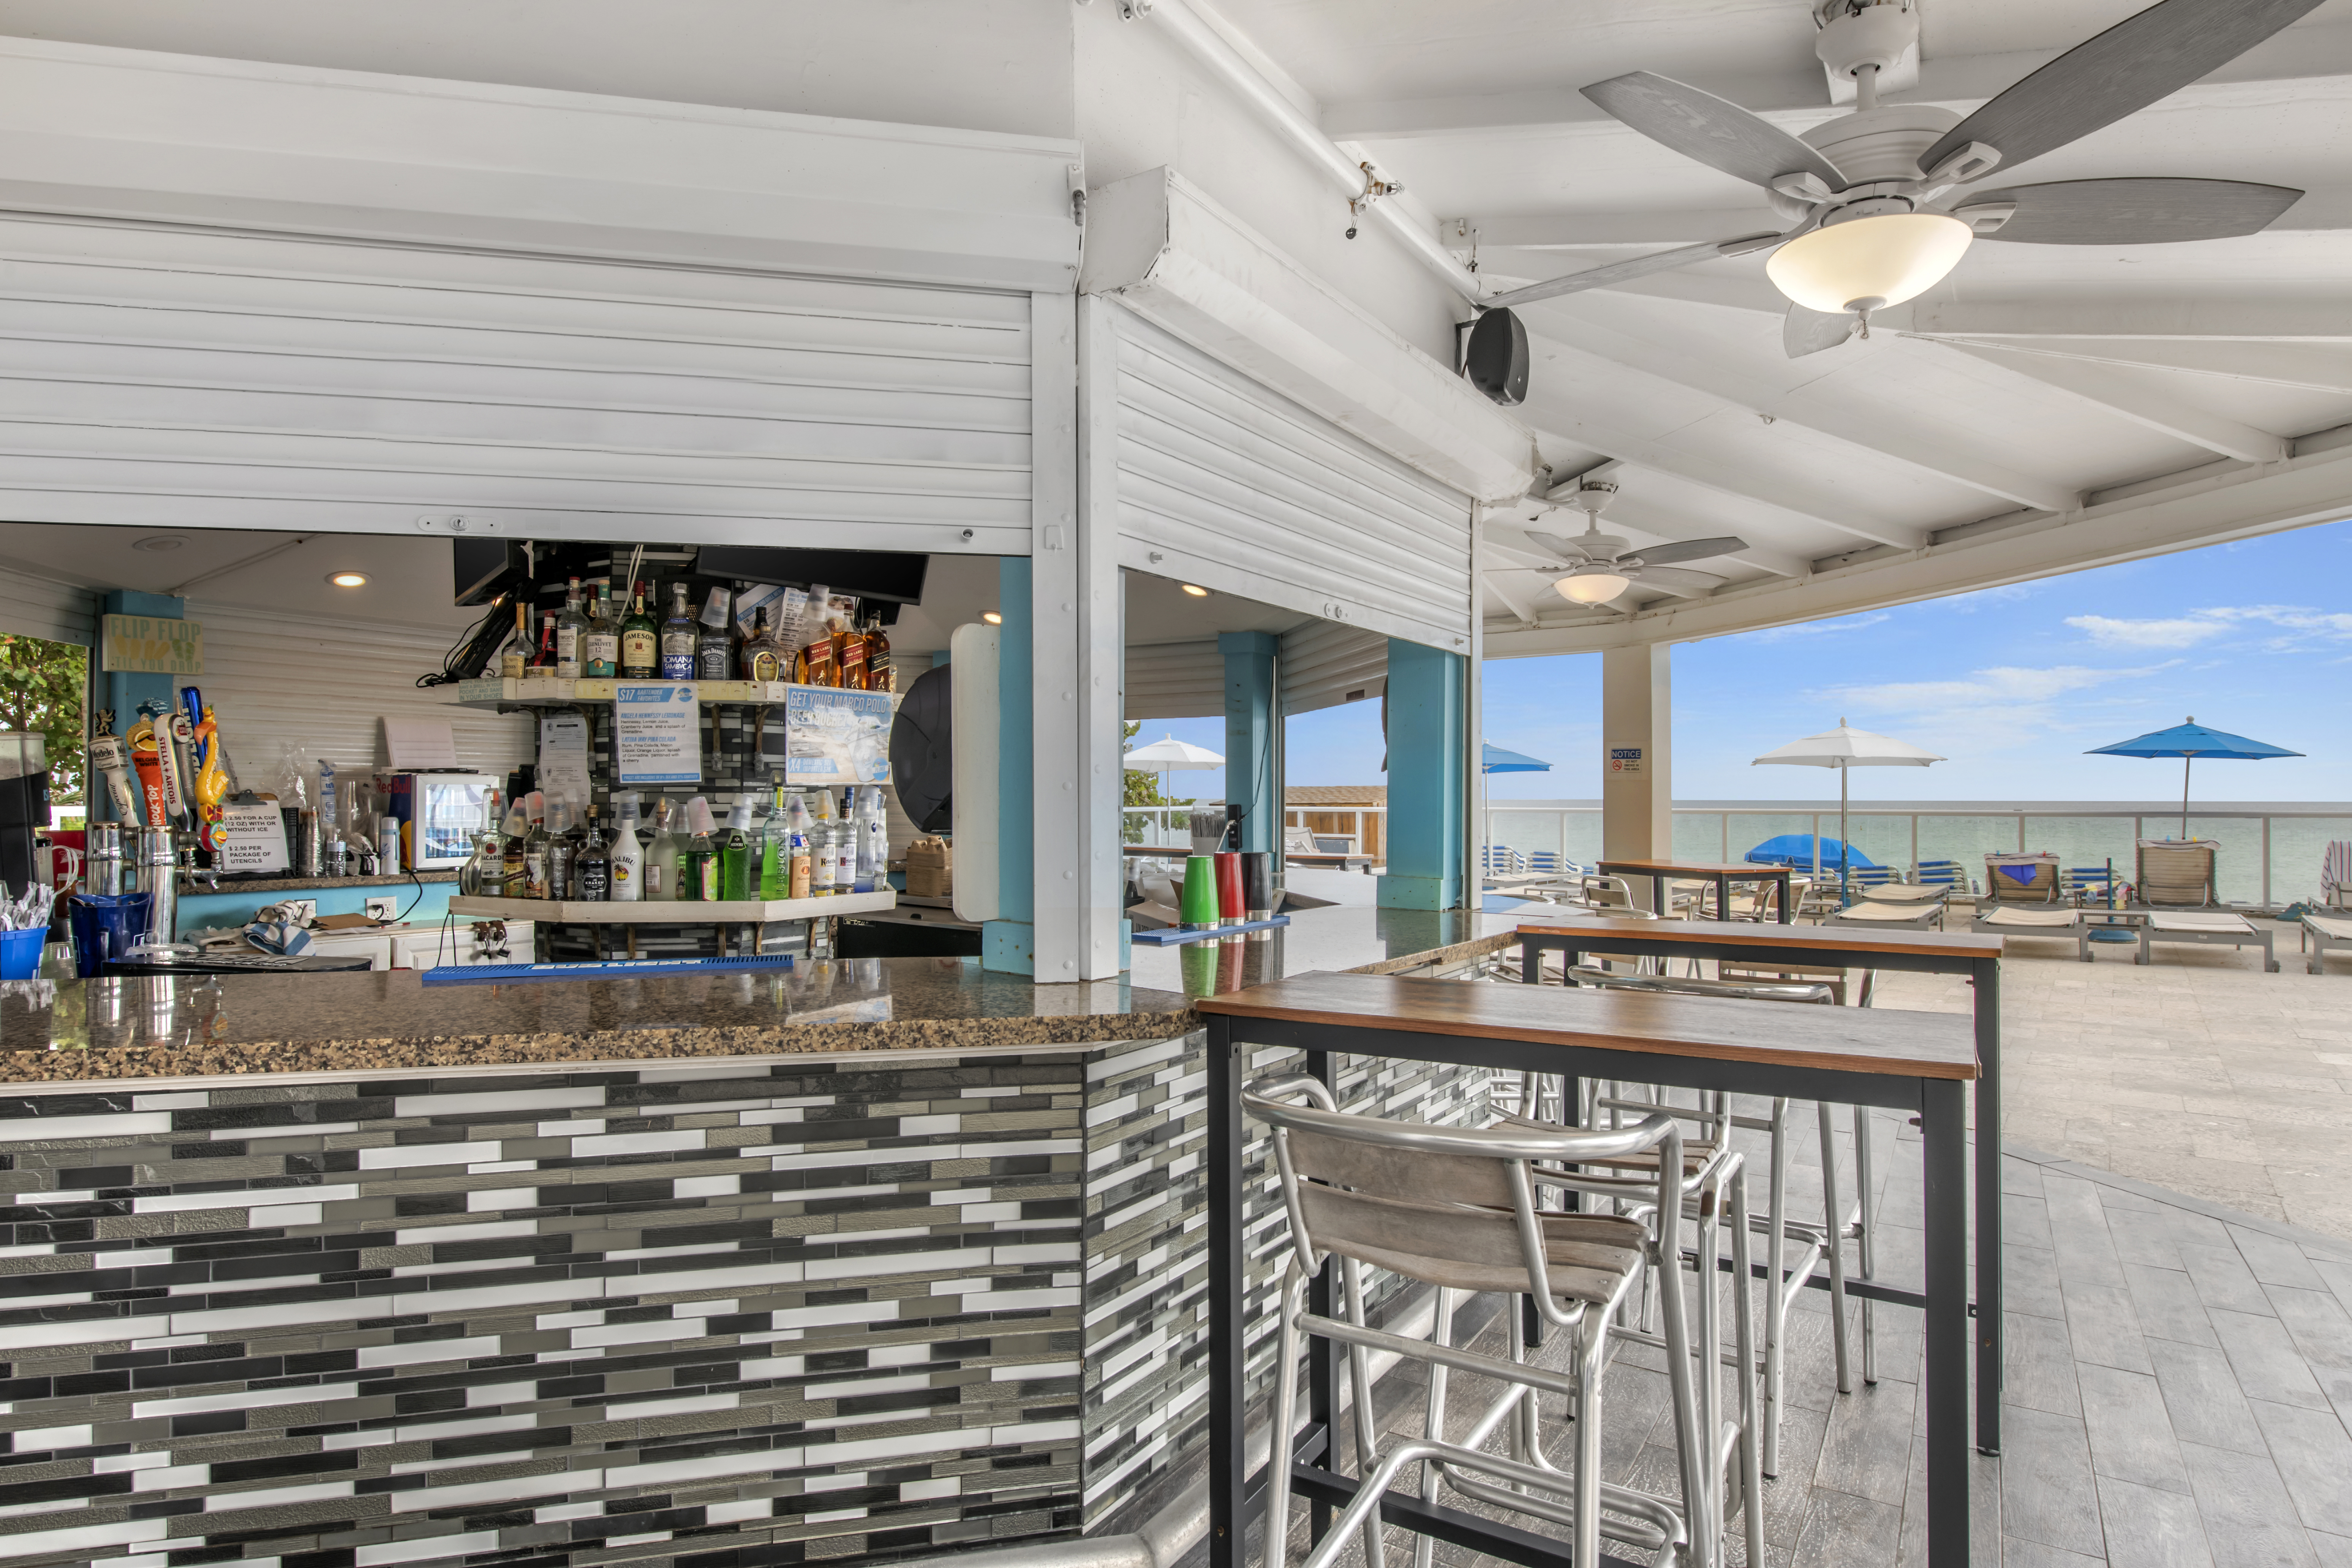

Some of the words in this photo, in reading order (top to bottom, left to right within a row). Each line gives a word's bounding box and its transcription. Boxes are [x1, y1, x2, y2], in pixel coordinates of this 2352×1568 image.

[740, 609, 753, 619] PLUNGE
[773, 588, 783, 596] MENU
[111, 616, 150, 639] FLIP
[158, 620, 201, 642] FLOP
[625, 633, 653, 642] JAMESON
[711, 648, 726, 657] DANIEL'S
[112, 656, 133, 669] 'TIL
[141, 658, 163, 671] YOU
[171, 660, 201, 673] DROP
[619, 689, 635, 701] $17
[790, 691, 808, 707] GET
[809, 693, 833, 709] YOUR
[834, 695, 865, 711] MARCO
[866, 698, 887, 713] POLO
[791, 709, 816, 725] BEER
[817, 711, 849, 727] BUCKET
[92, 748, 114, 759] Modelo
[158, 737, 169, 765] STELLA
[165, 775, 176, 804] ARTOIS
[192, 755, 201, 779] UD
[790, 758, 800, 771] X4
[147, 784, 159, 802] TOP
[376, 777, 392, 793] Red
[394, 777, 410, 793] Bull
[150, 802, 161, 825] HOCK
[611, 856, 635, 866] MALIBU
[776, 837, 786, 893] LEBLON
[840, 857, 852, 866] Ketel
